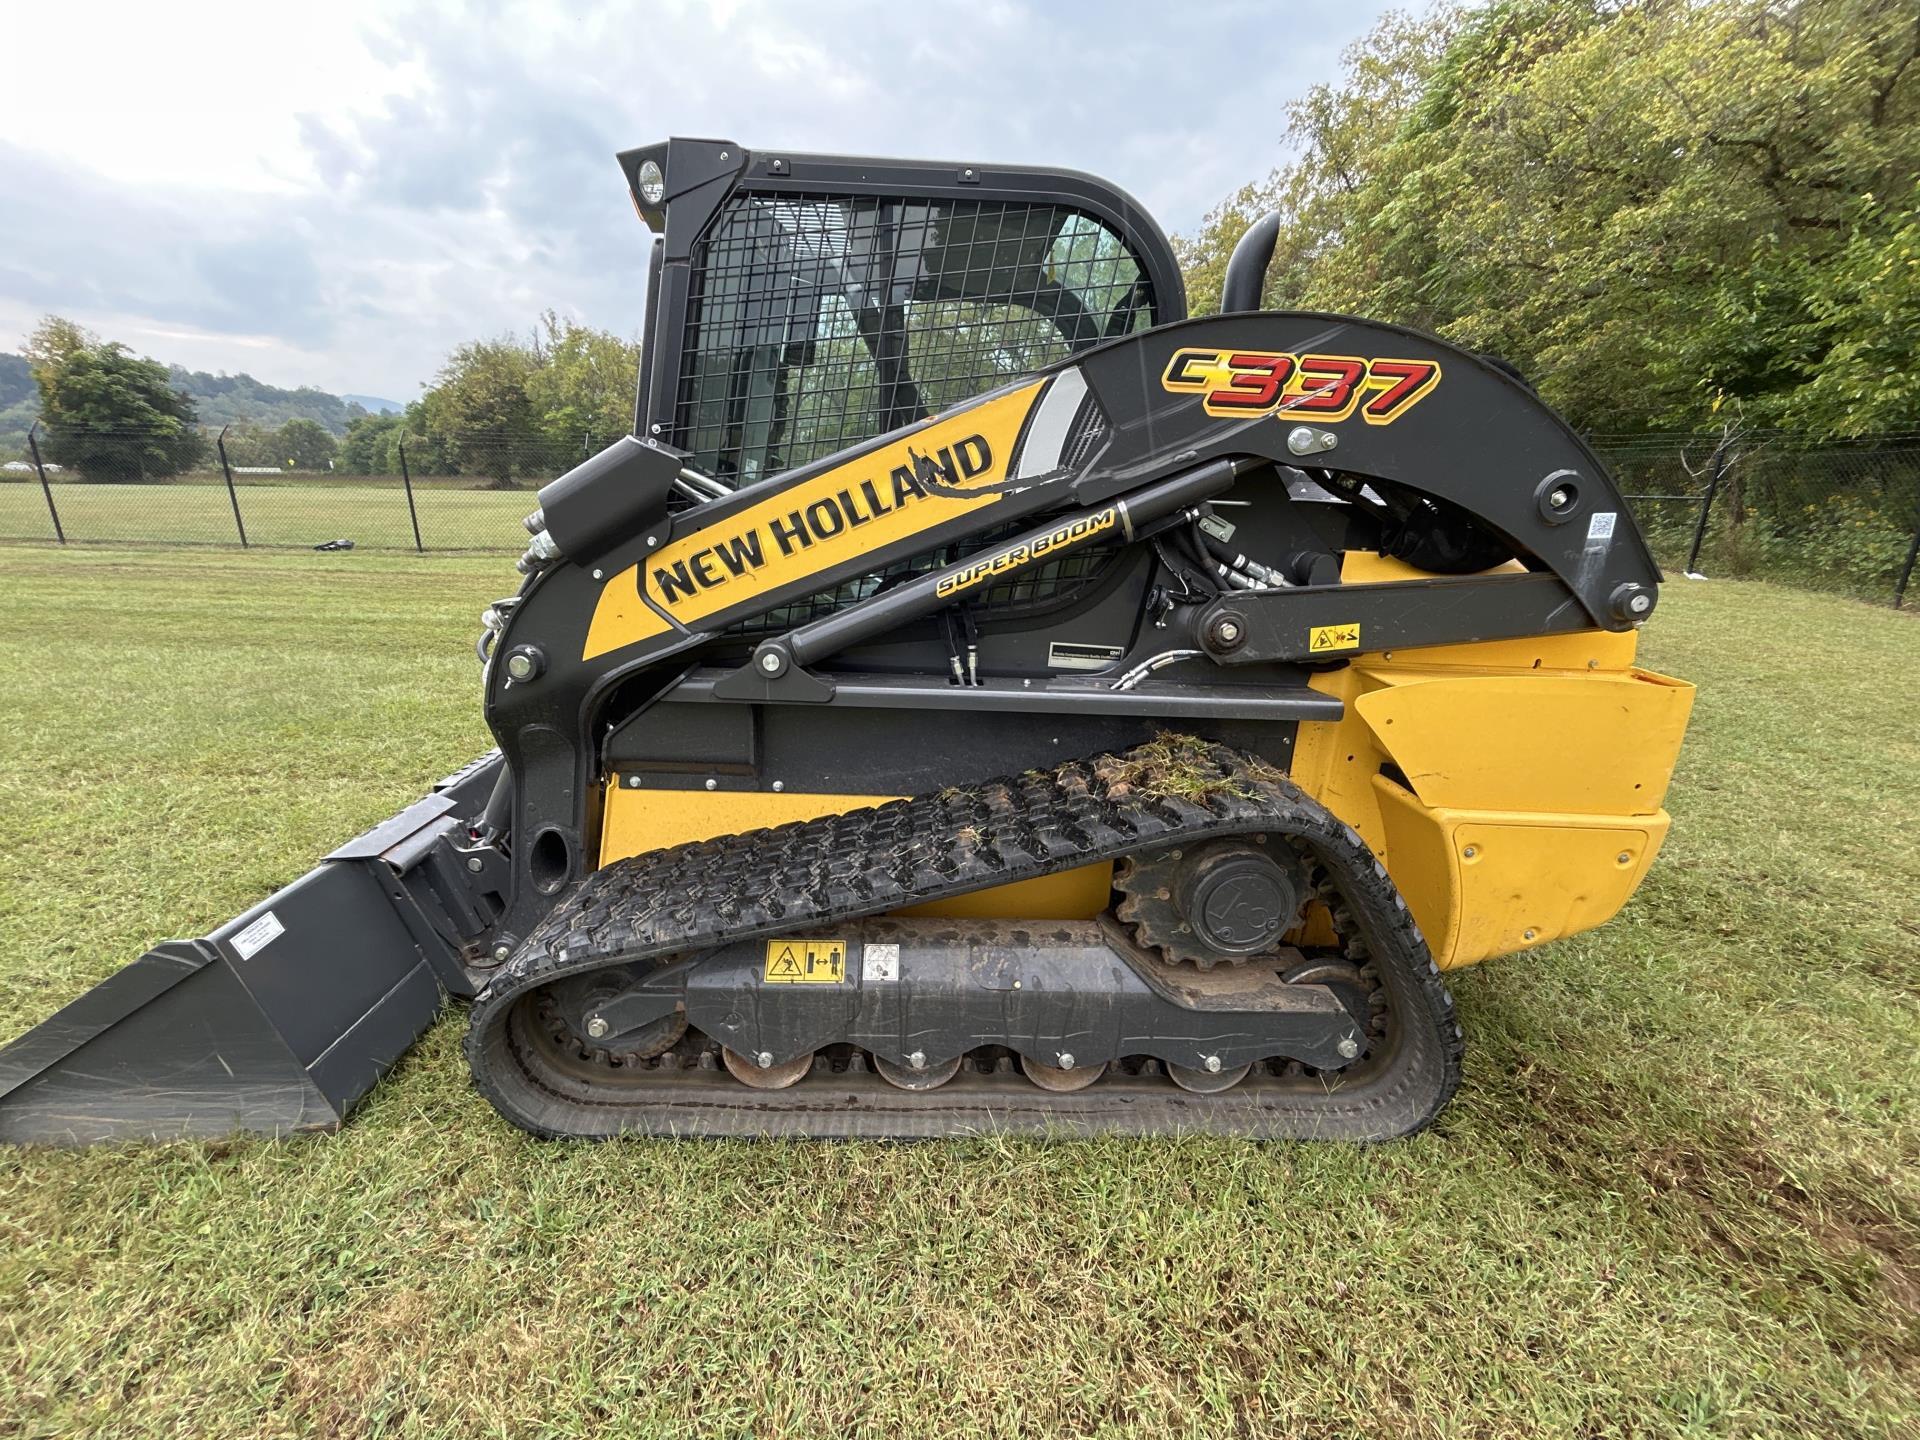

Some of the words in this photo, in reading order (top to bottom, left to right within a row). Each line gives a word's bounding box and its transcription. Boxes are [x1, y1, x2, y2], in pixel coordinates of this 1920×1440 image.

[1163, 349, 1441, 424] C337
[653, 528, 766, 605] NEW
[769, 433, 994, 557] HOLLAND
[937, 545, 1030, 598] SUPER
[1032, 508, 1115, 558] BOOM
